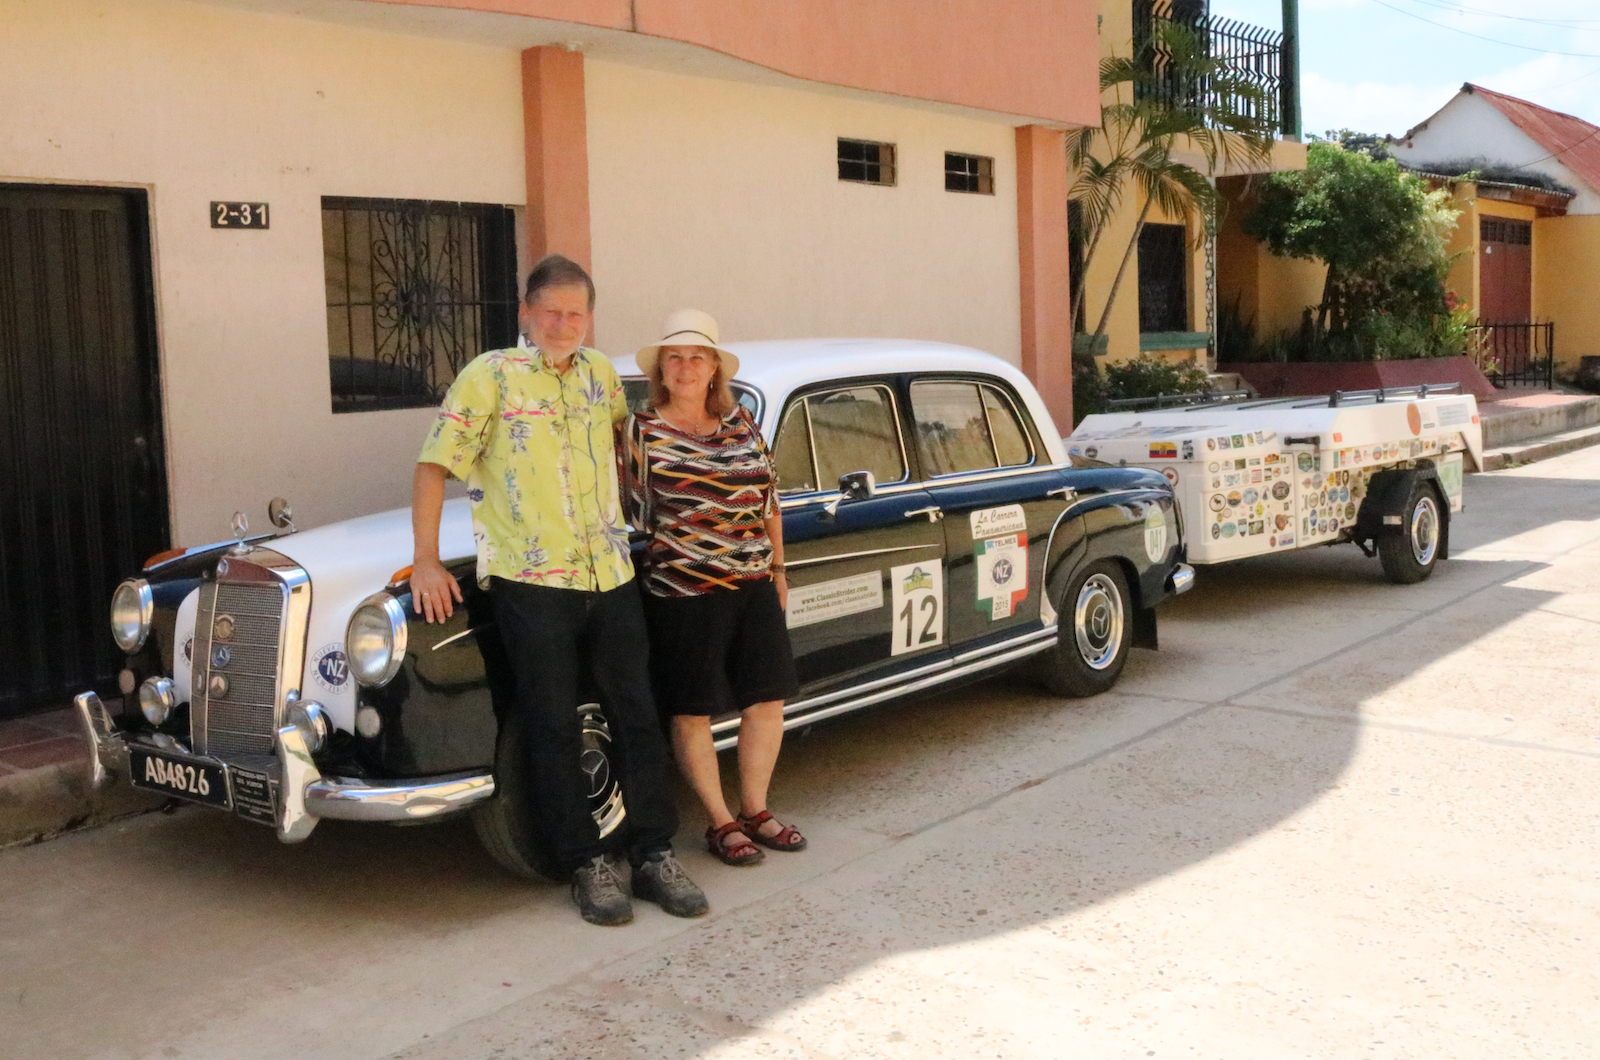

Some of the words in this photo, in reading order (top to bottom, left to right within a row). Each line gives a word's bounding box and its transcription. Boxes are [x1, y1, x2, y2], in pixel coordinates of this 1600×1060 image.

[217, 203, 266, 225] 2-31
[977, 512, 988, 524] La
[990, 509, 1018, 523] Carrera
[974, 522, 1024, 537] Panamericana
[994, 537, 1017, 547] TELMEX
[996, 564, 1009, 580] NZ
[792, 591, 878, 615] www.facebook.com/classicstrider
[801, 585, 869, 605] www.ClassicStrider.com
[995, 600, 1009, 611] 2015
[900, 594, 938, 648] 12
[313, 644, 335, 663] NUEVA
[312, 669, 326, 687] NEW
[326, 658, 345, 679] NZ
[145, 756, 210, 796] AB4826
